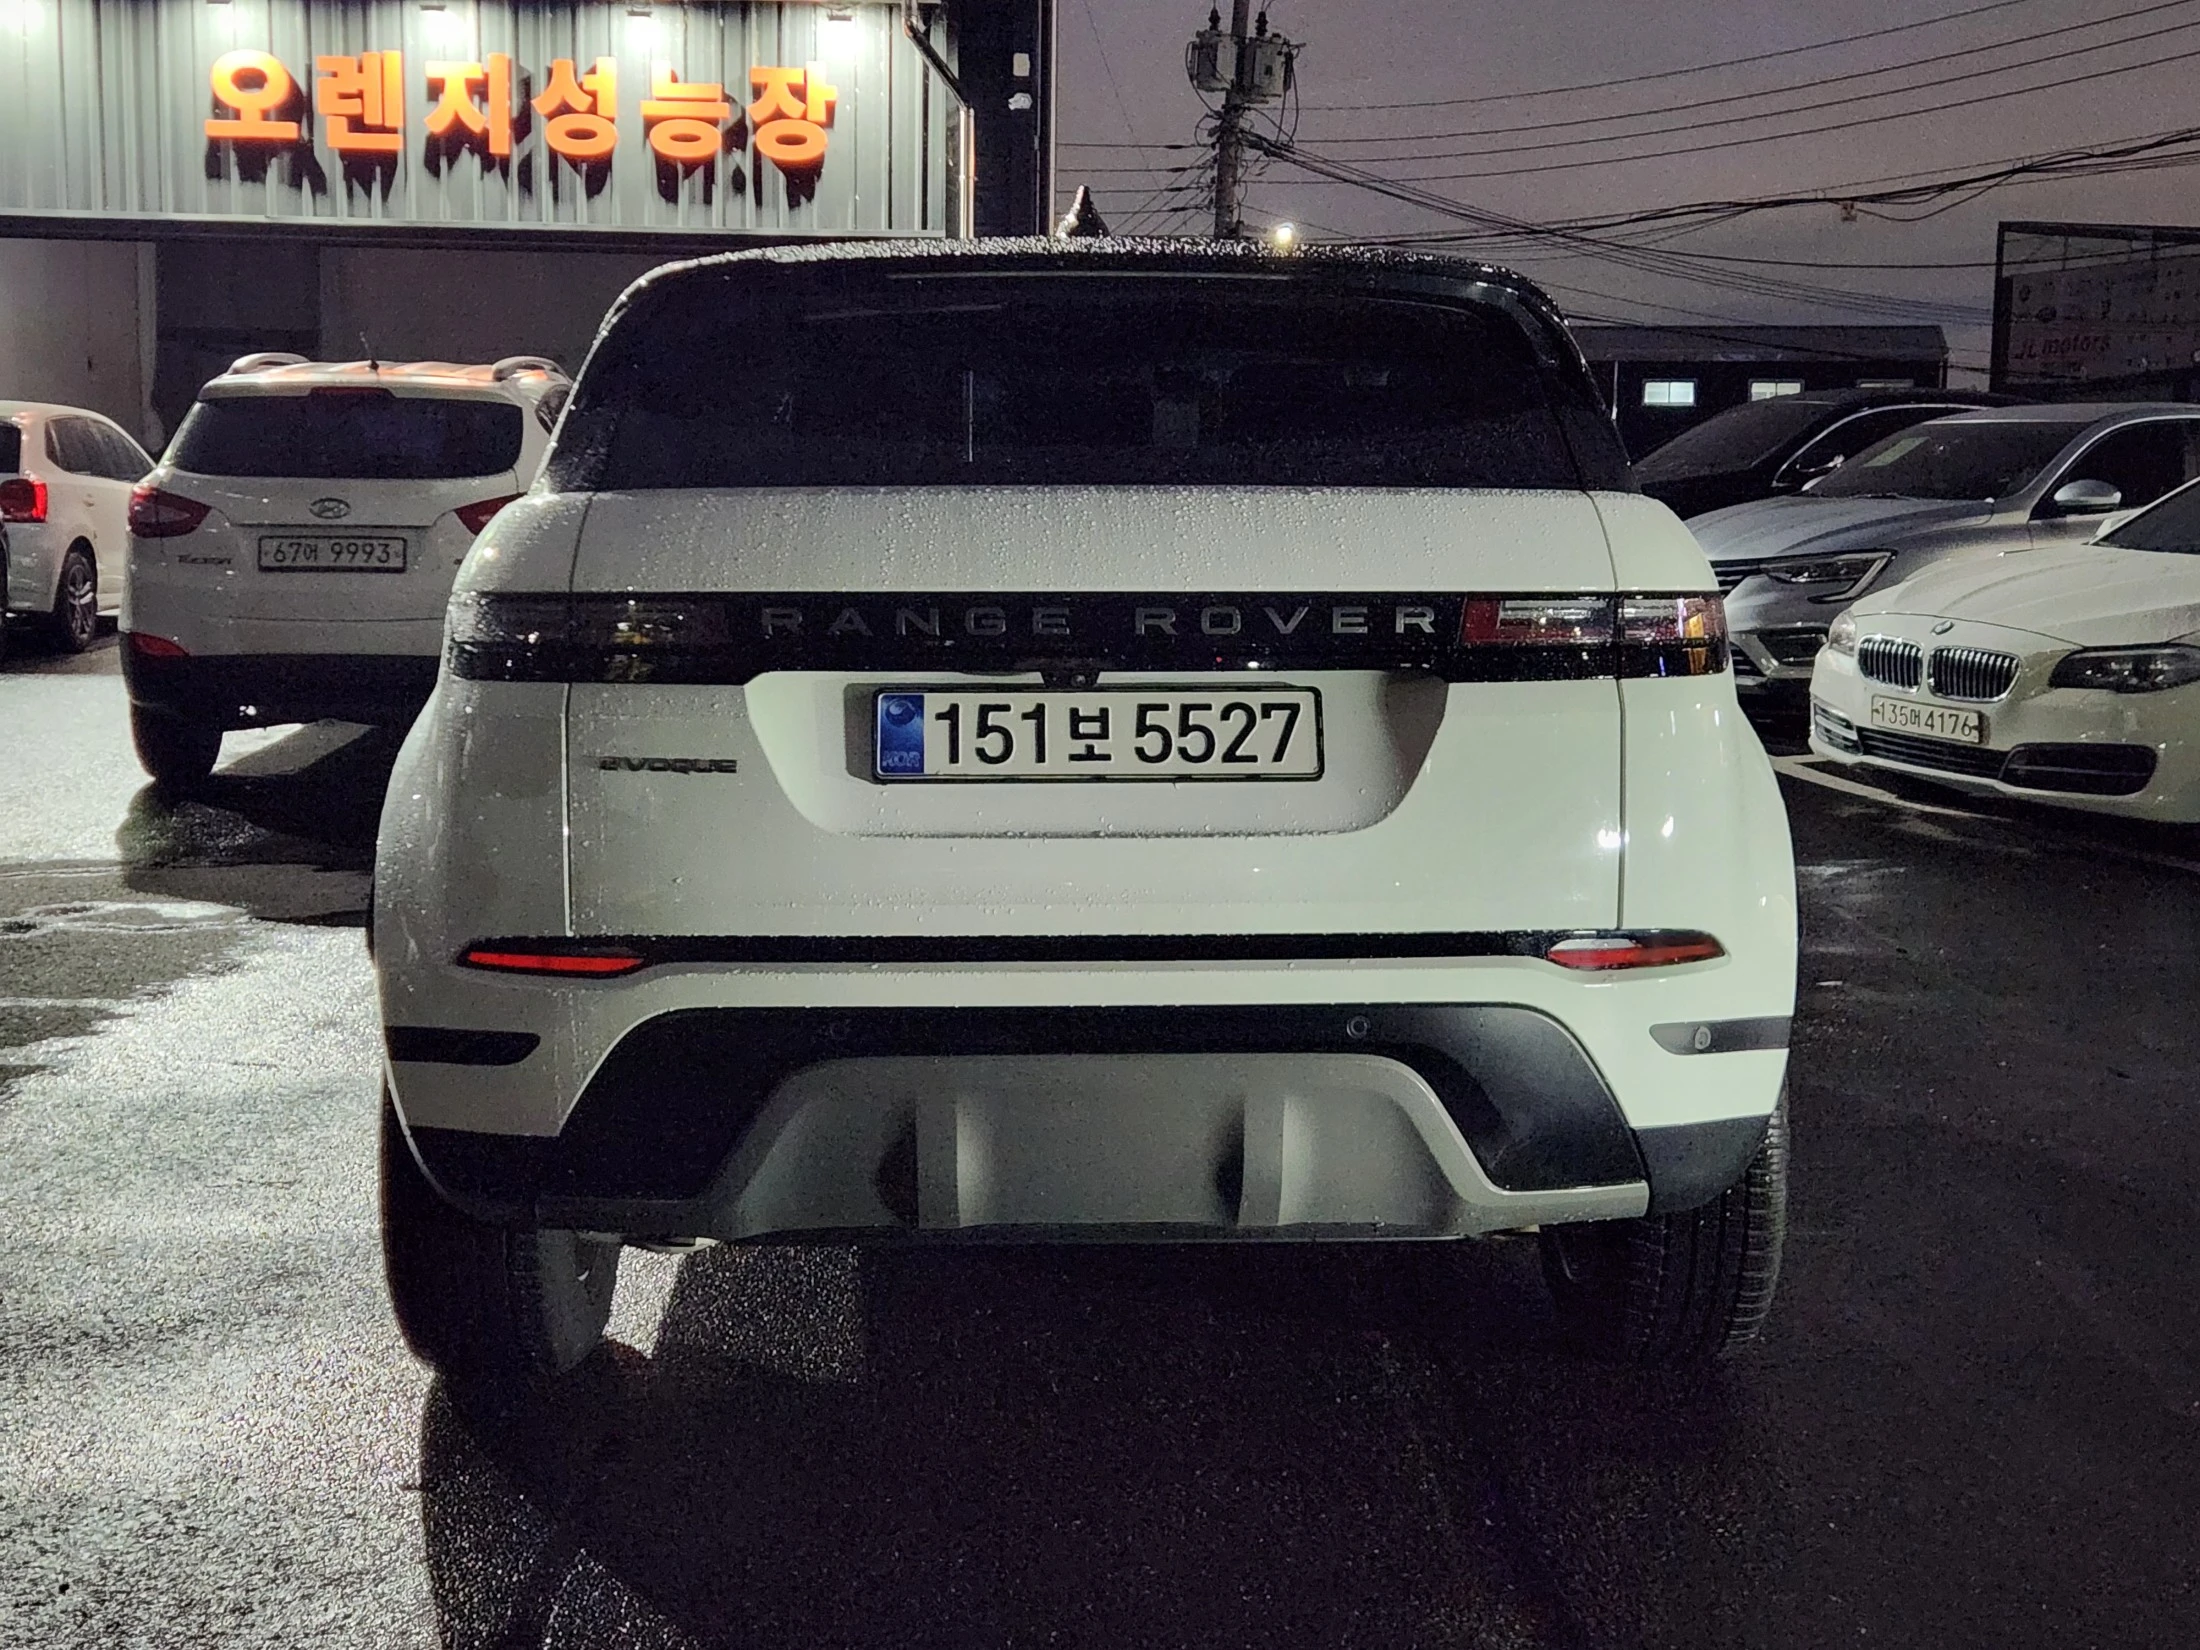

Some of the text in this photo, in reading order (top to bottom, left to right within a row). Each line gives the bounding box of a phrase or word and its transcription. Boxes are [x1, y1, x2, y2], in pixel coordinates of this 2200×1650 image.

[204, 48, 838, 164] 오렌지성능장
[330, 541, 391, 564] 9993
[760, 606, 1437, 637] RANGE ROVER
[1134, 702, 1302, 765] 5527
[1924, 710, 1972, 737] 4176
